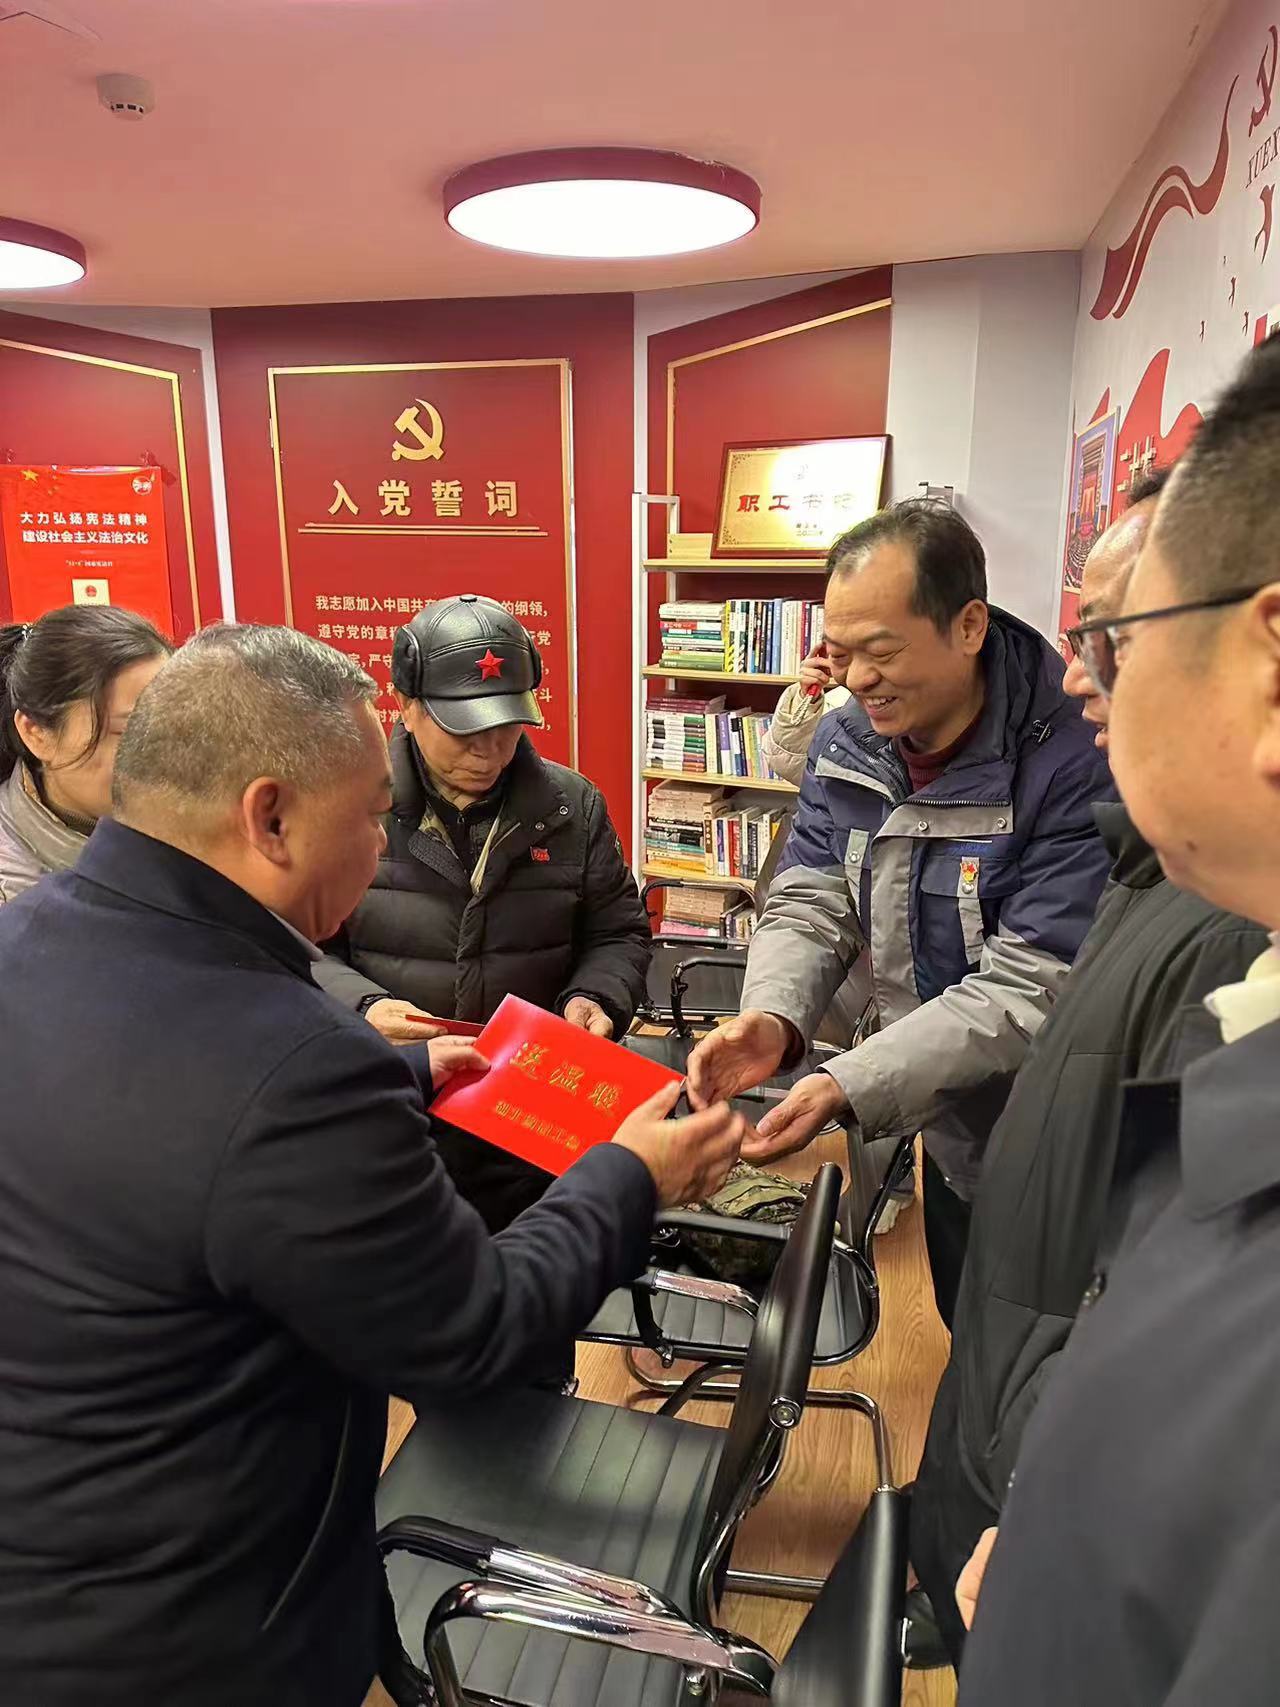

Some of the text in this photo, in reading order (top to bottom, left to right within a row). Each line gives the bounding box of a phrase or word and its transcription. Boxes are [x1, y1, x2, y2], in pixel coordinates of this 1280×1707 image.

[328, 479, 518, 518] 入党誓词
[20, 511, 148, 526] 大力弘扬宪法精神
[22, 530, 149, 545] 建设社会主义法治文化
